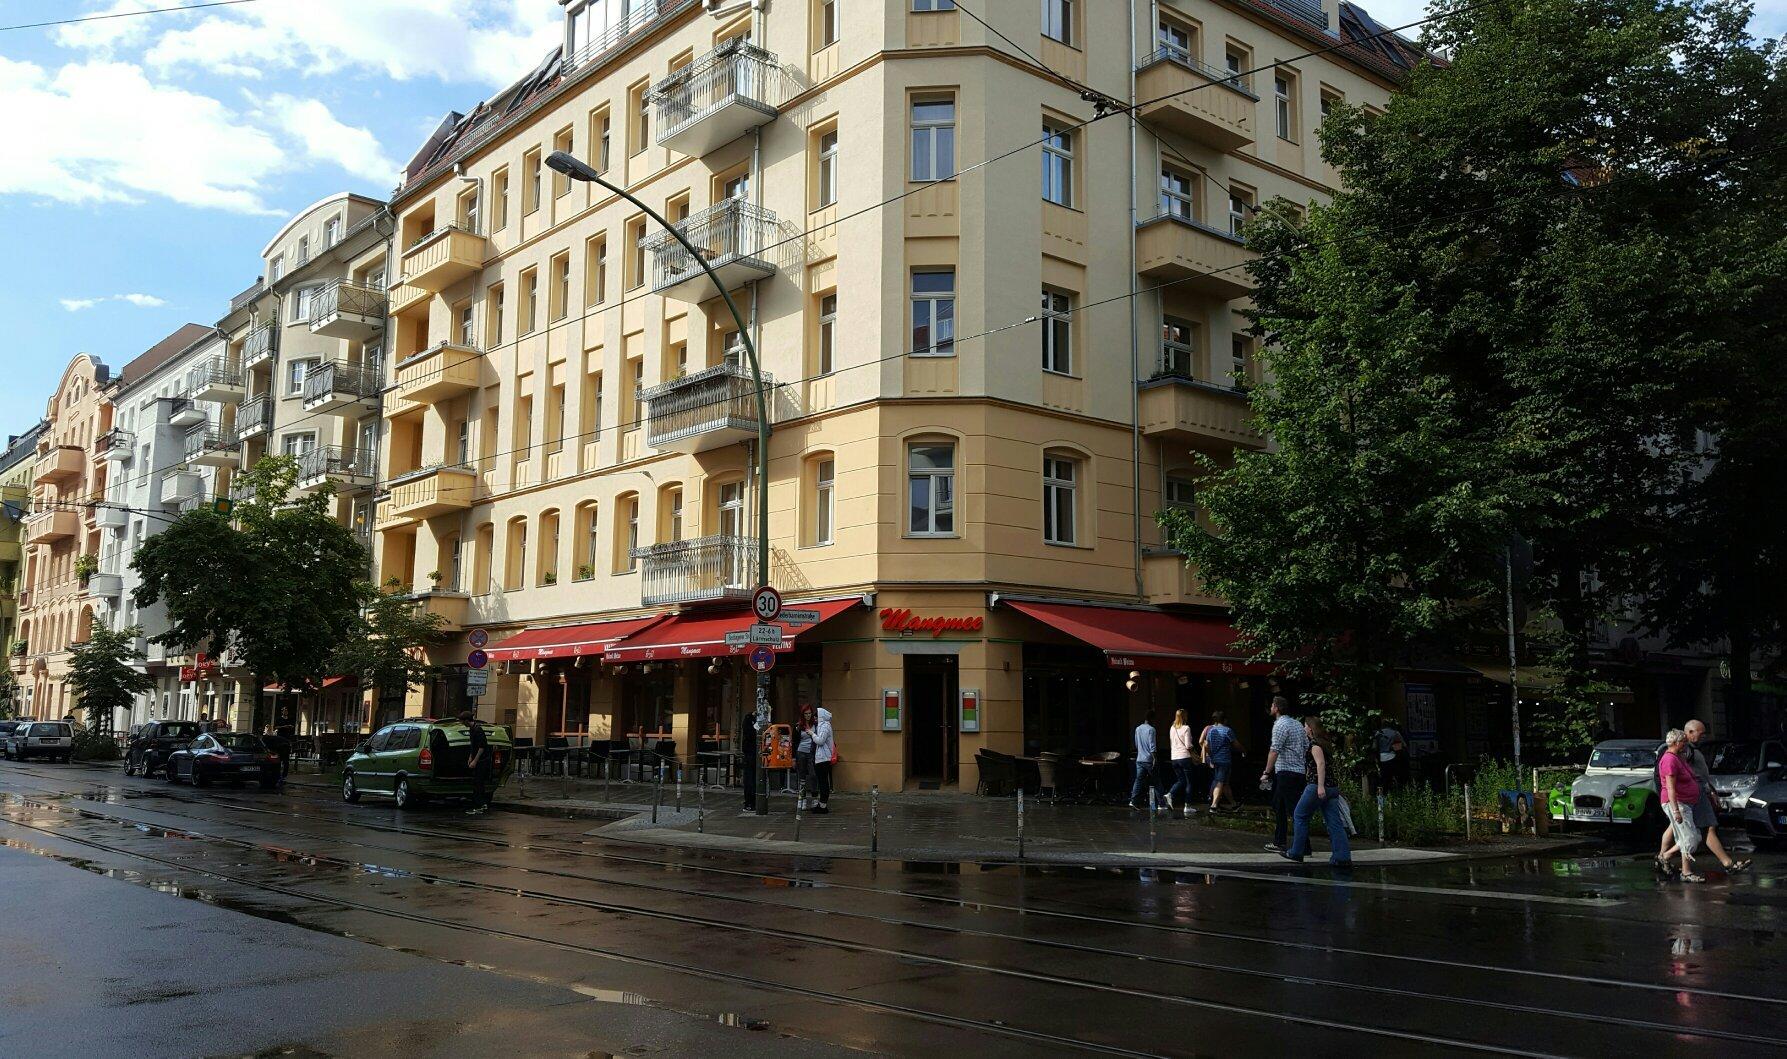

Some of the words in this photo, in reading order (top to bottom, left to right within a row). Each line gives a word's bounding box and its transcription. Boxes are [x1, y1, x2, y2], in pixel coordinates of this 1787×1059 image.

[758, 596, 776, 612] 30
[879, 607, 984, 637] Mangmee
[758, 627, 771, 635] 22-6
